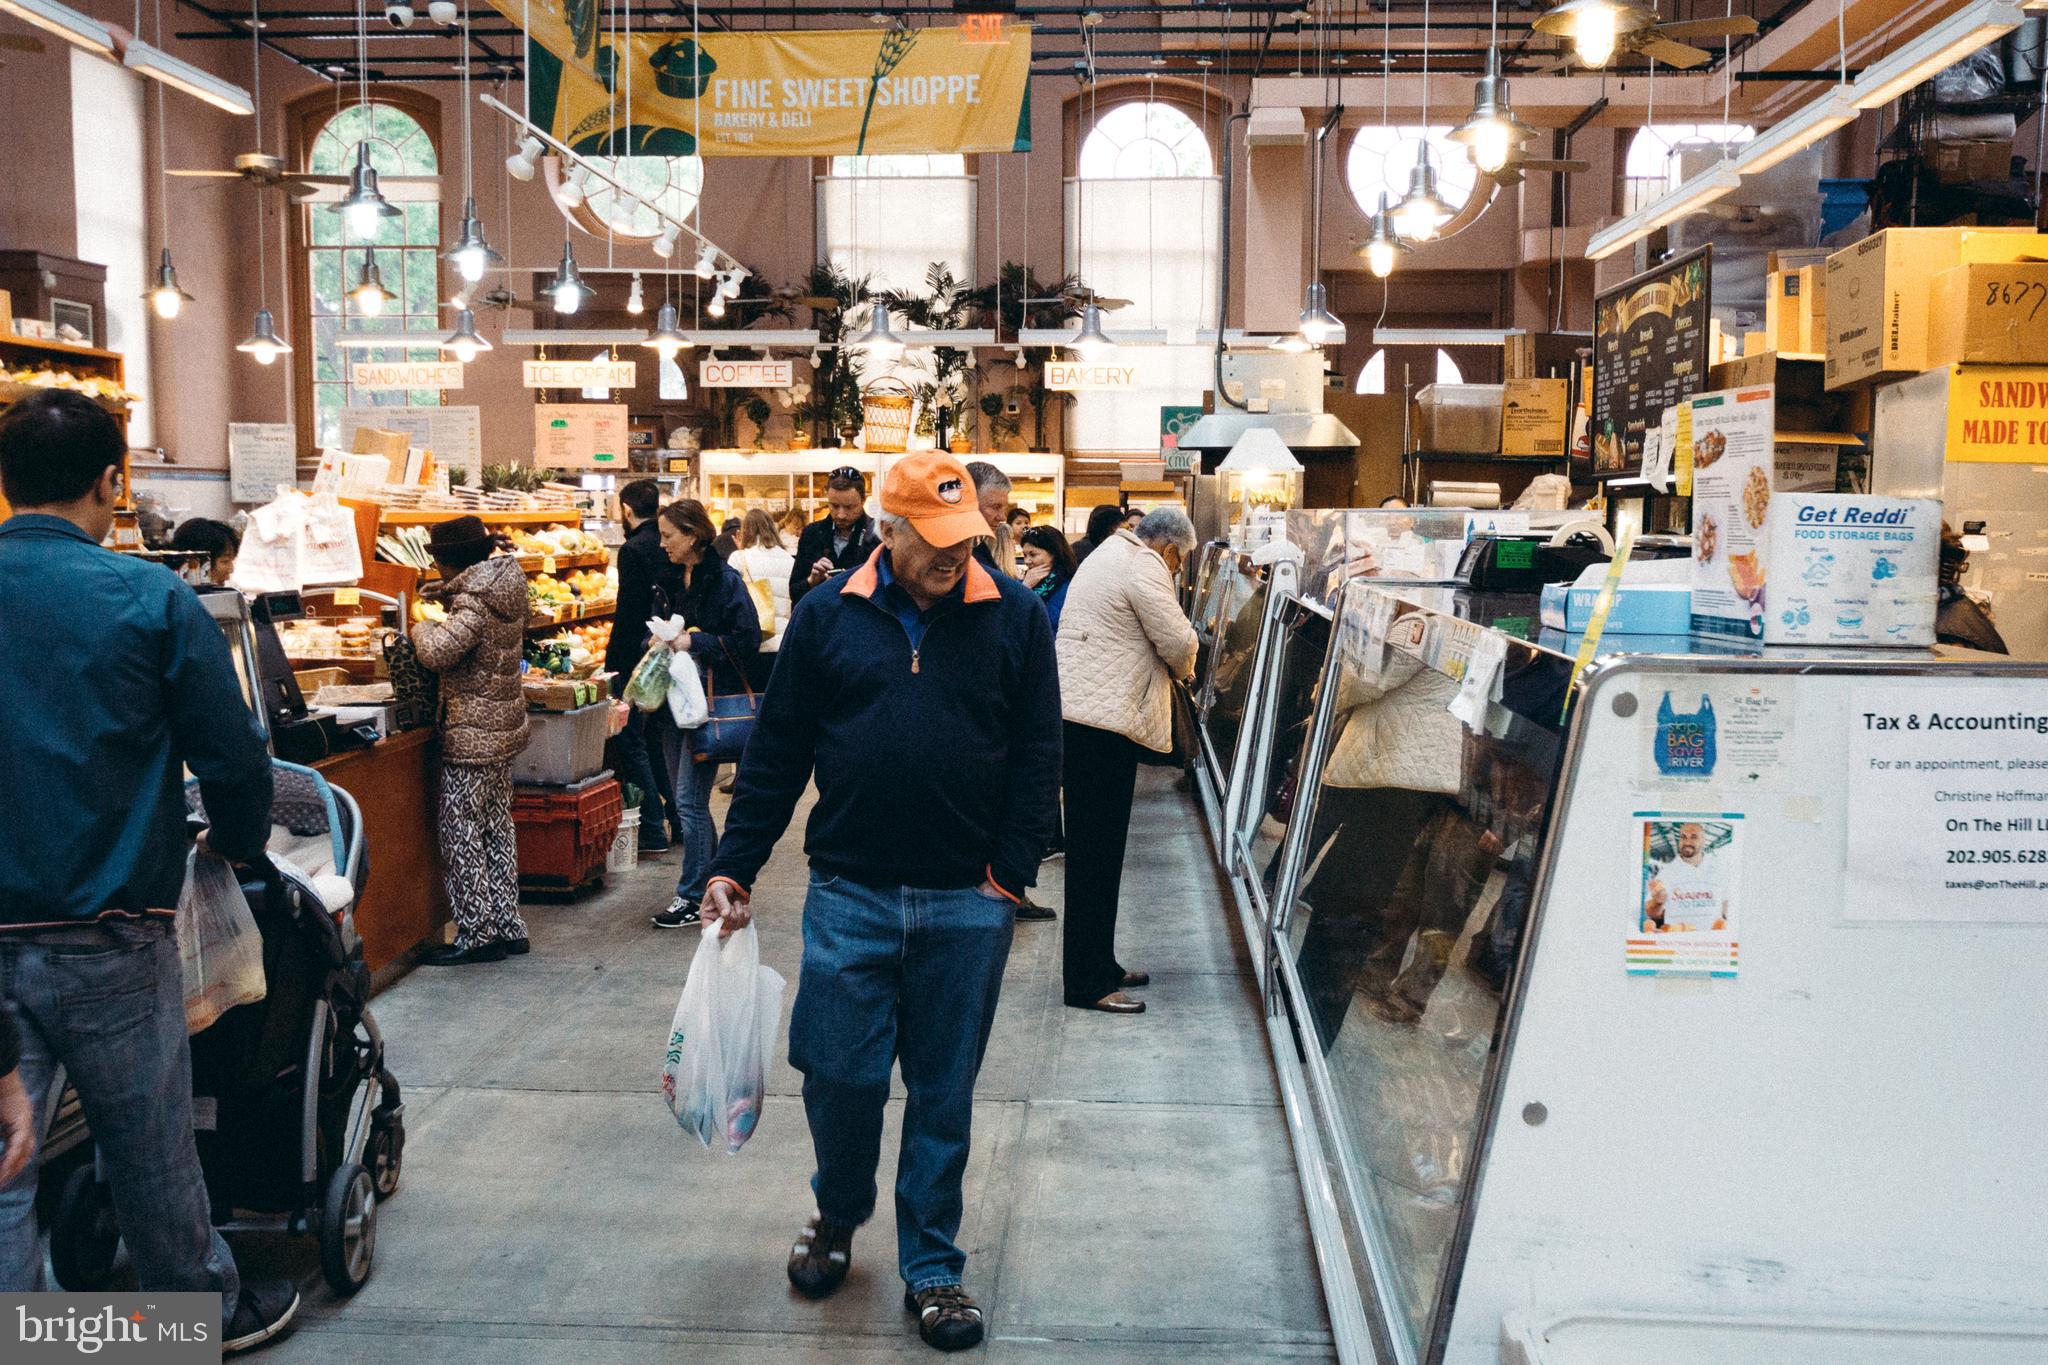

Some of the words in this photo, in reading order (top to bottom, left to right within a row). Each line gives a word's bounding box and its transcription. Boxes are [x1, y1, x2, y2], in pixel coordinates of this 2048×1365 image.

[967, 14, 1003, 42] EXIT
[715, 79, 774, 109] FINE
[781, 77, 869, 109] SWEET
[877, 73, 981, 106] SHOPPE
[715, 112, 765, 129] BAKERY
[769, 111, 779, 129] &
[782, 111, 812, 129] DELI
[1986, 281, 2048, 321] 8677
[357, 366, 460, 386] SANDWICHES
[529, 366, 566, 383] ICE
[571, 366, 632, 384] CREAM
[706, 365, 787, 383] COFFEE
[1050, 366, 1134, 385] BAKERY
[1963, 420, 2019, 444] MADE
[1798, 505, 1838, 523] Get
[1844, 506, 1909, 525] Reddi
[1795, 530, 1824, 540] FOOD
[1829, 530, 1880, 541] STORAGE
[1884, 531, 1914, 542] BAGS
[1863, 713, 1900, 730] Tax
[1907, 714, 1920, 730] &
[1928, 712, 2048, 734] Accounting
[1667, 732, 1705, 747] BAG
[1668, 746, 1705, 758] save
[1672, 757, 1705, 768] RIVER
[1870, 758, 1891, 770] For
[1895, 761, 1911, 770] an
[1915, 759, 2003, 773] appointment,
[2007, 758, 2048, 773] please
[1934, 790, 1992, 802] Christine
[1946, 818, 1969, 832] On
[1973, 818, 2002, 832] The
[2008, 818, 2032, 832] Hill
[1946, 850, 2048, 864] 202.905.628
